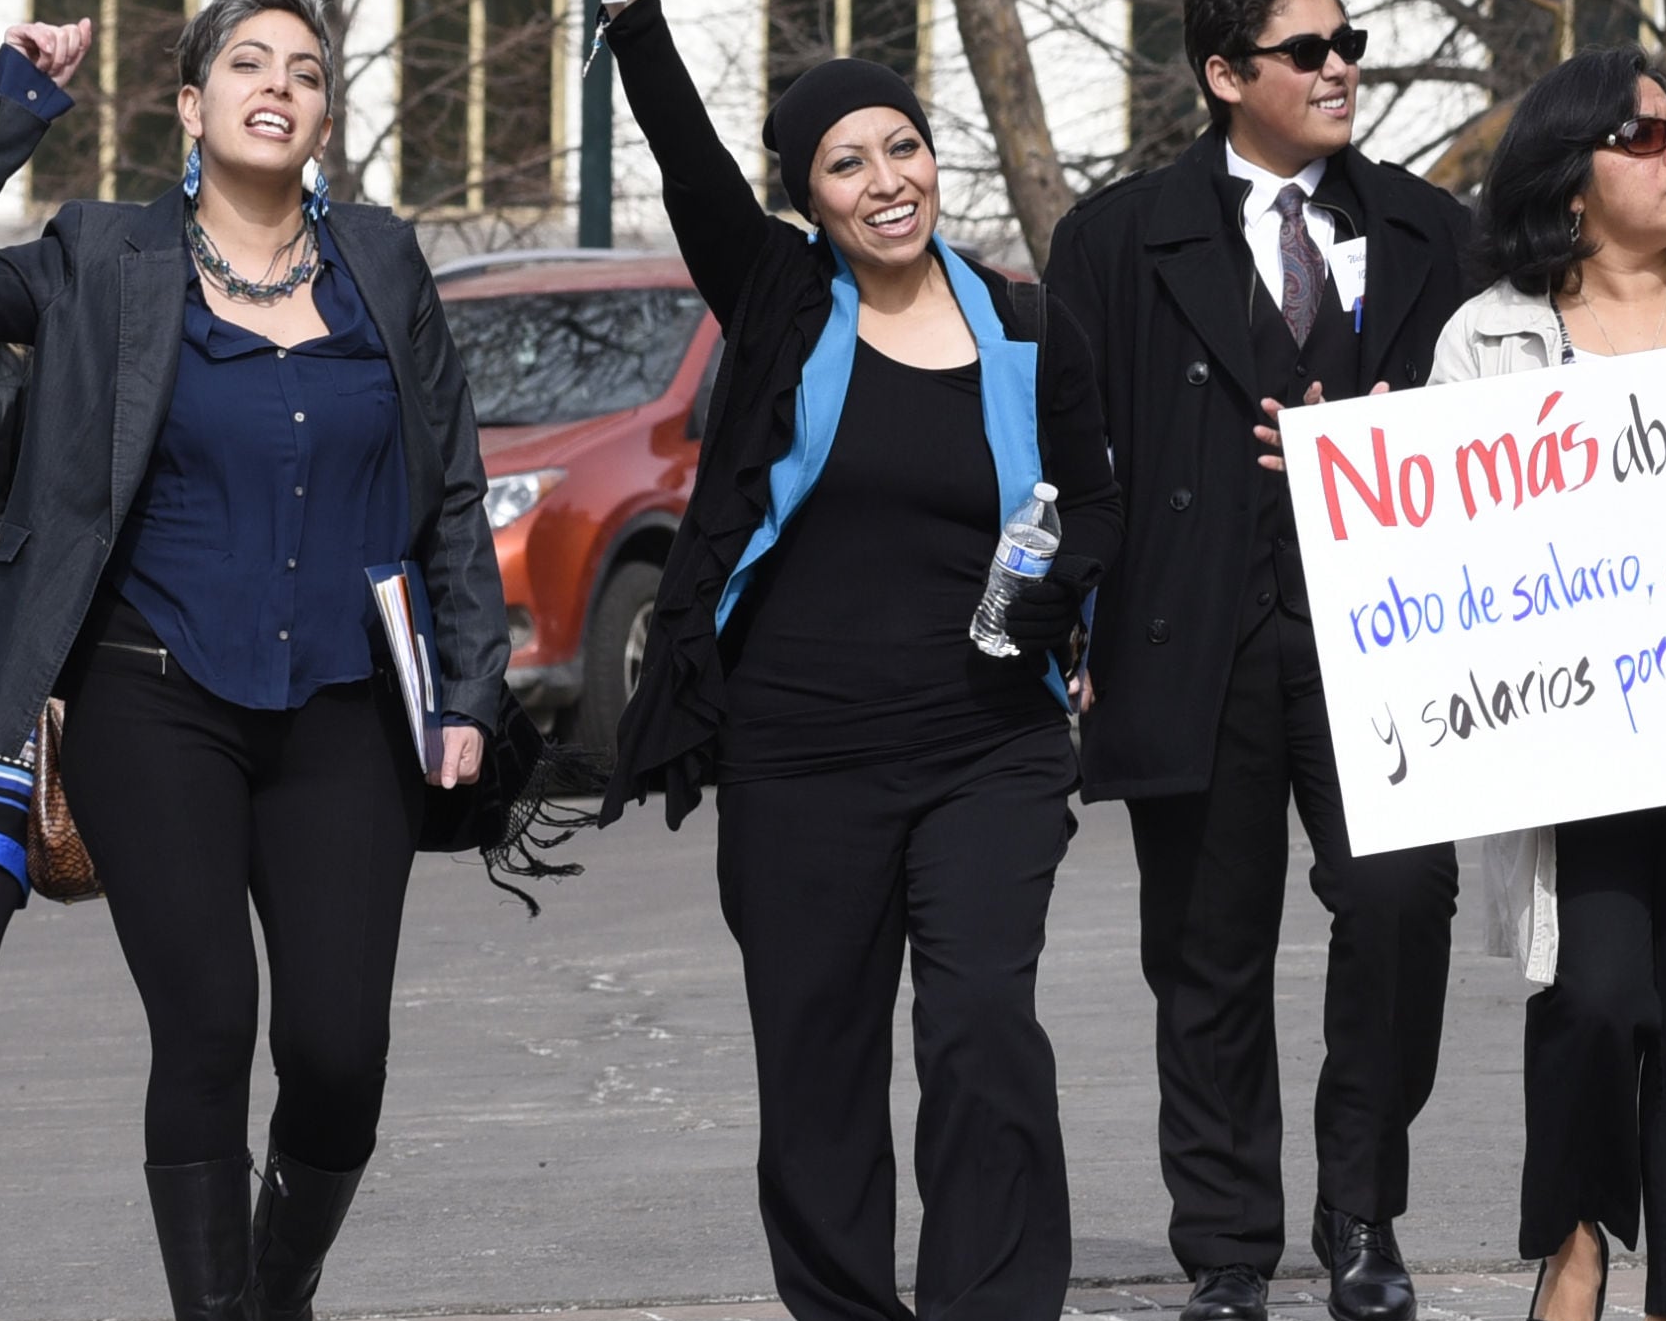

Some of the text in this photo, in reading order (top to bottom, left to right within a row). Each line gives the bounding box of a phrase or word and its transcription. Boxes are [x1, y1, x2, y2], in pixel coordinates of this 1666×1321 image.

[1316, 427, 1434, 541] No
[1456, 391, 1598, 520] más
[1350, 577, 1444, 653] robo
[1459, 565, 1502, 630] de
[1513, 542, 1654, 622] salario,
[1371, 701, 1408, 786] y
[1422, 657, 1596, 748] salarios
[1615, 637, 1666, 734] por
